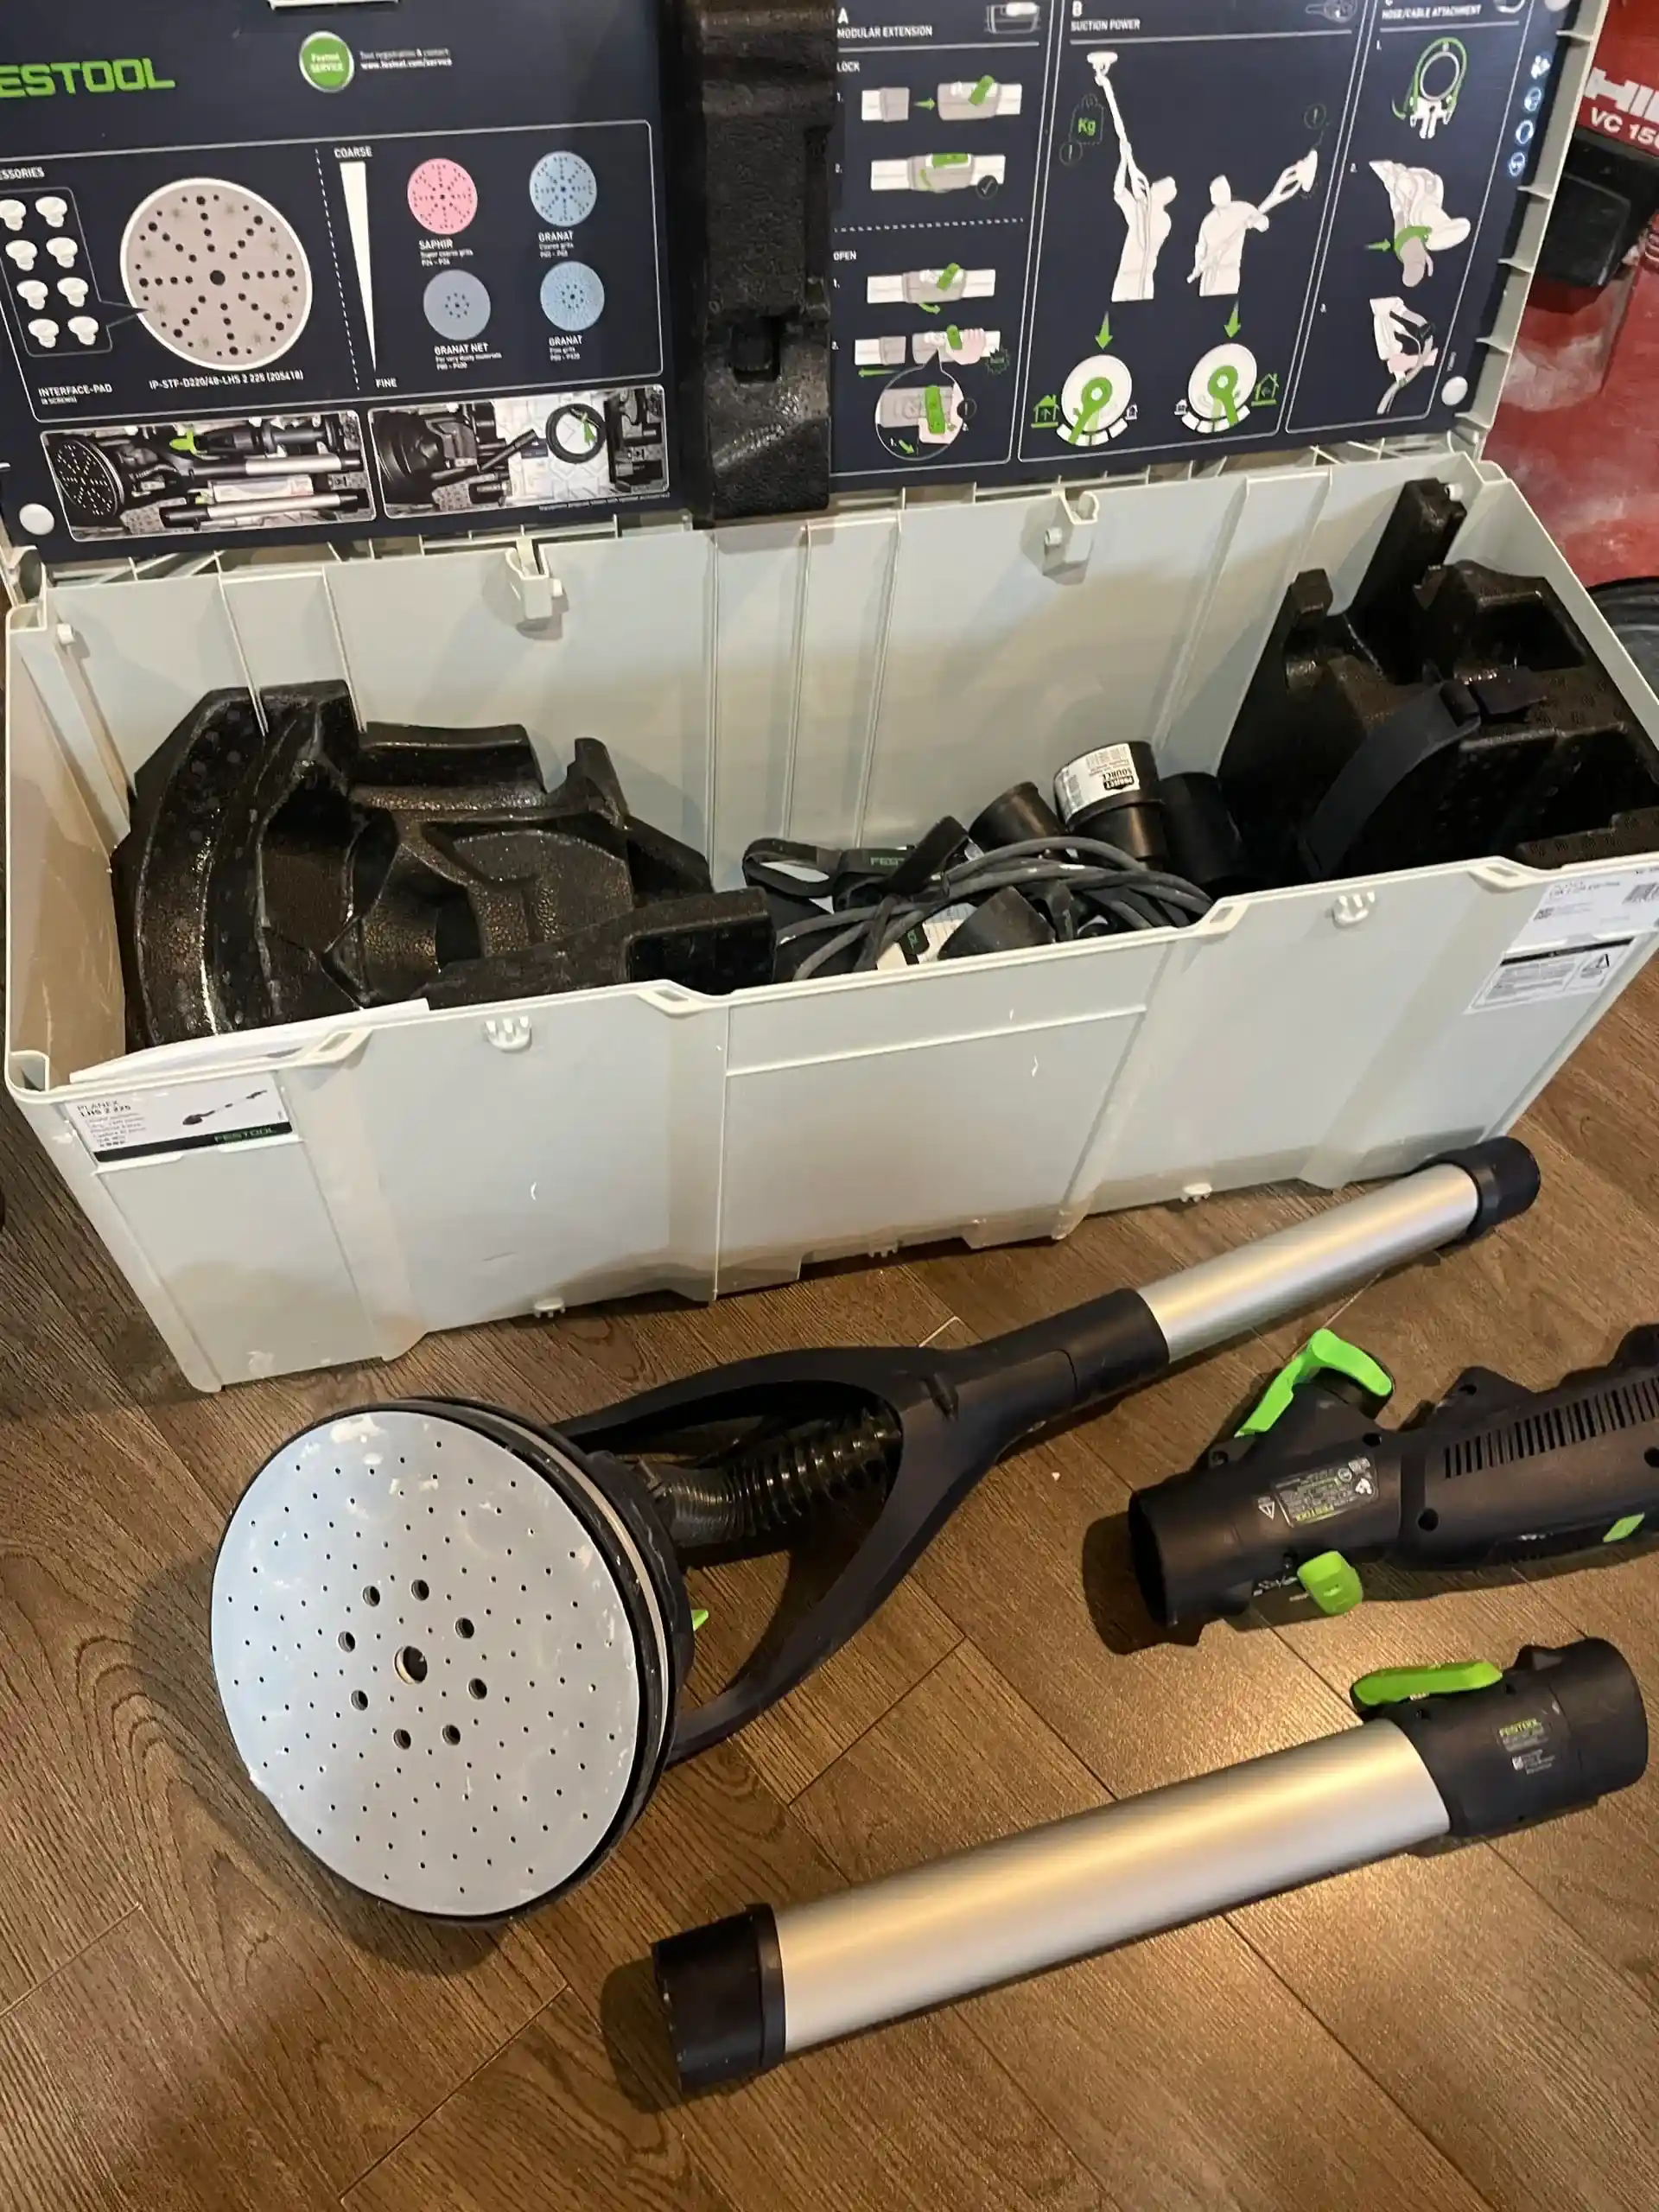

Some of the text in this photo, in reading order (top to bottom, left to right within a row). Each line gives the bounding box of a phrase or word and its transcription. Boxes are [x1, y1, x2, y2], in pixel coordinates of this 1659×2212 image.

[1072, 1, 1083, 16] B
[836, 7, 849, 24] A
[1071, 18, 1141, 31] SUCTION POWER
[836, 25, 933, 38] MODULAR EXTENSION
[836, 60, 861, 73] LOCK
[1077, 118, 1096, 136] Kg
[1591, 106, 1659, 149] VC 15
[334, 146, 372, 159] COARSE
[538, 230, 574, 242] GRANAT
[419, 239, 454, 251] SAPHIR
[833, 250, 857, 261] OPEN
[549, 335, 582, 346] GRANAT
[434, 342, 488, 355] GRANAT NET
[375, 378, 397, 388] FINE
[38, 383, 113, 397] INTERFACE-PAD
